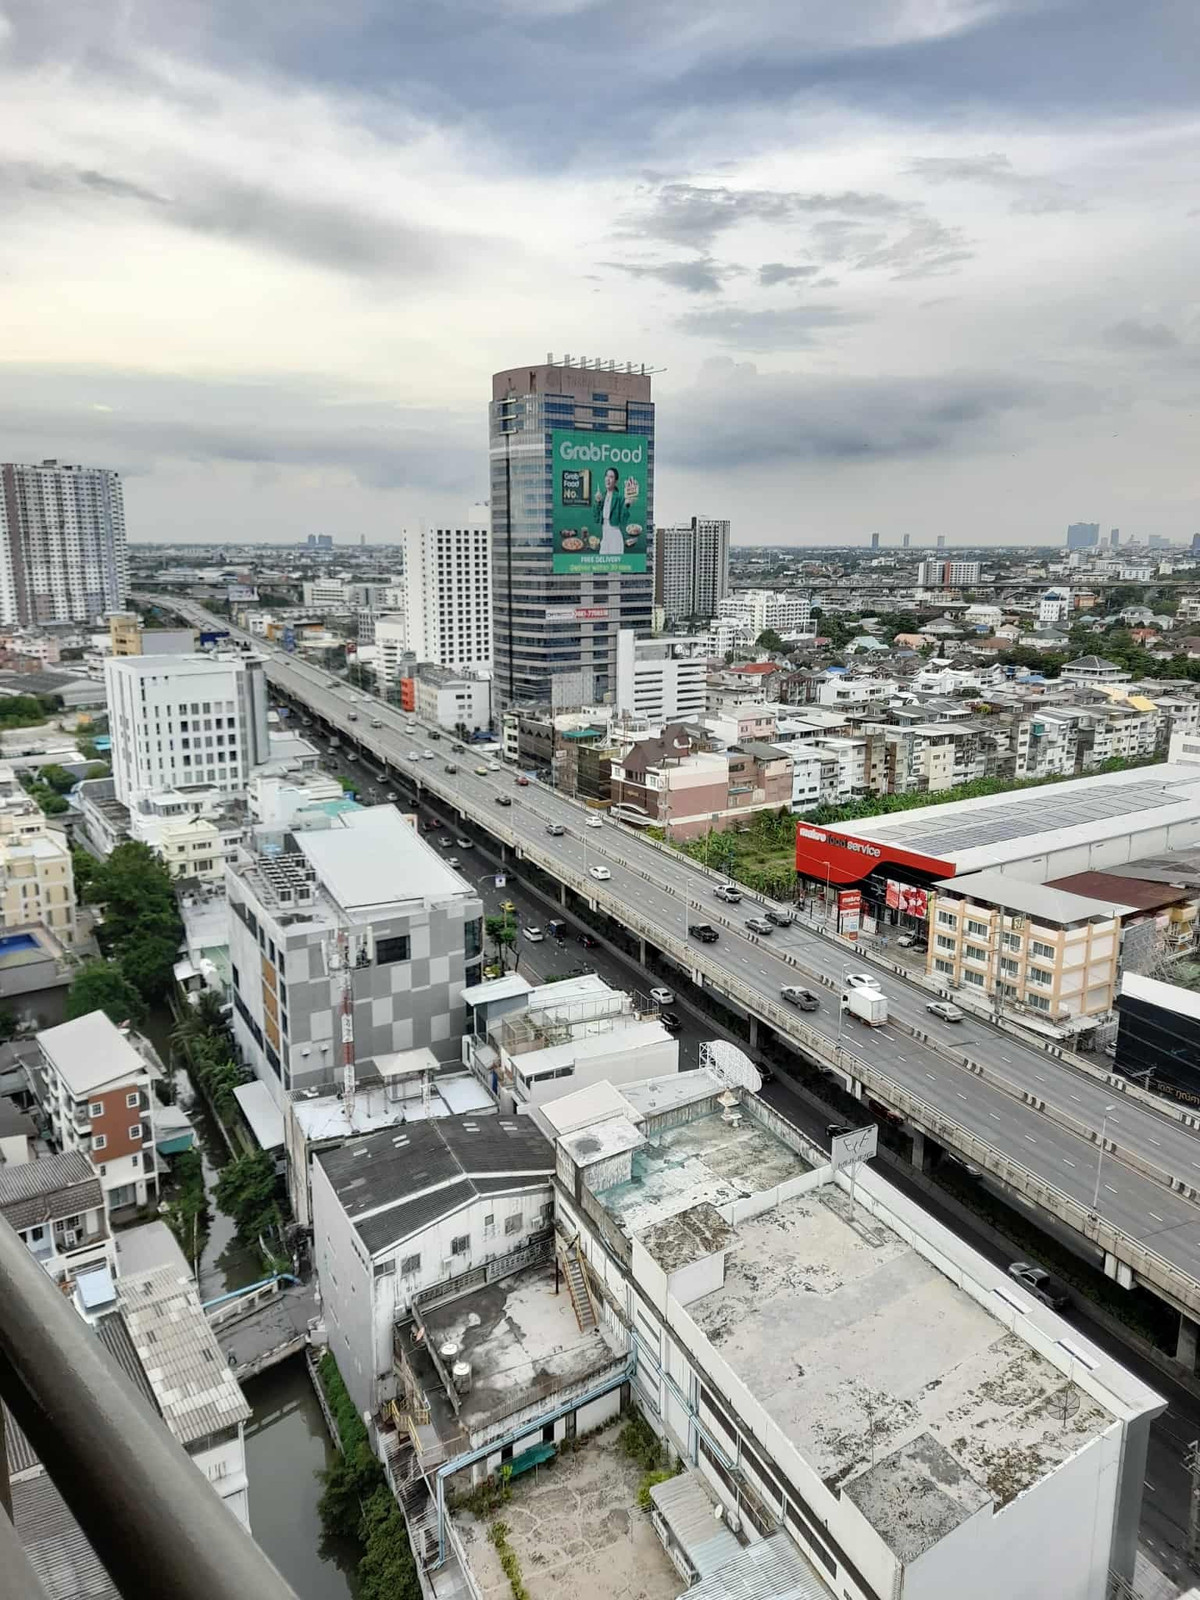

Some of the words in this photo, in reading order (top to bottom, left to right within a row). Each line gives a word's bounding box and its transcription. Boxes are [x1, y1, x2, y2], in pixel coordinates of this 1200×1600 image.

[560, 441, 642, 463] GrabFood
[580, 469, 590, 500] 1
[847, 841, 880, 857] service
